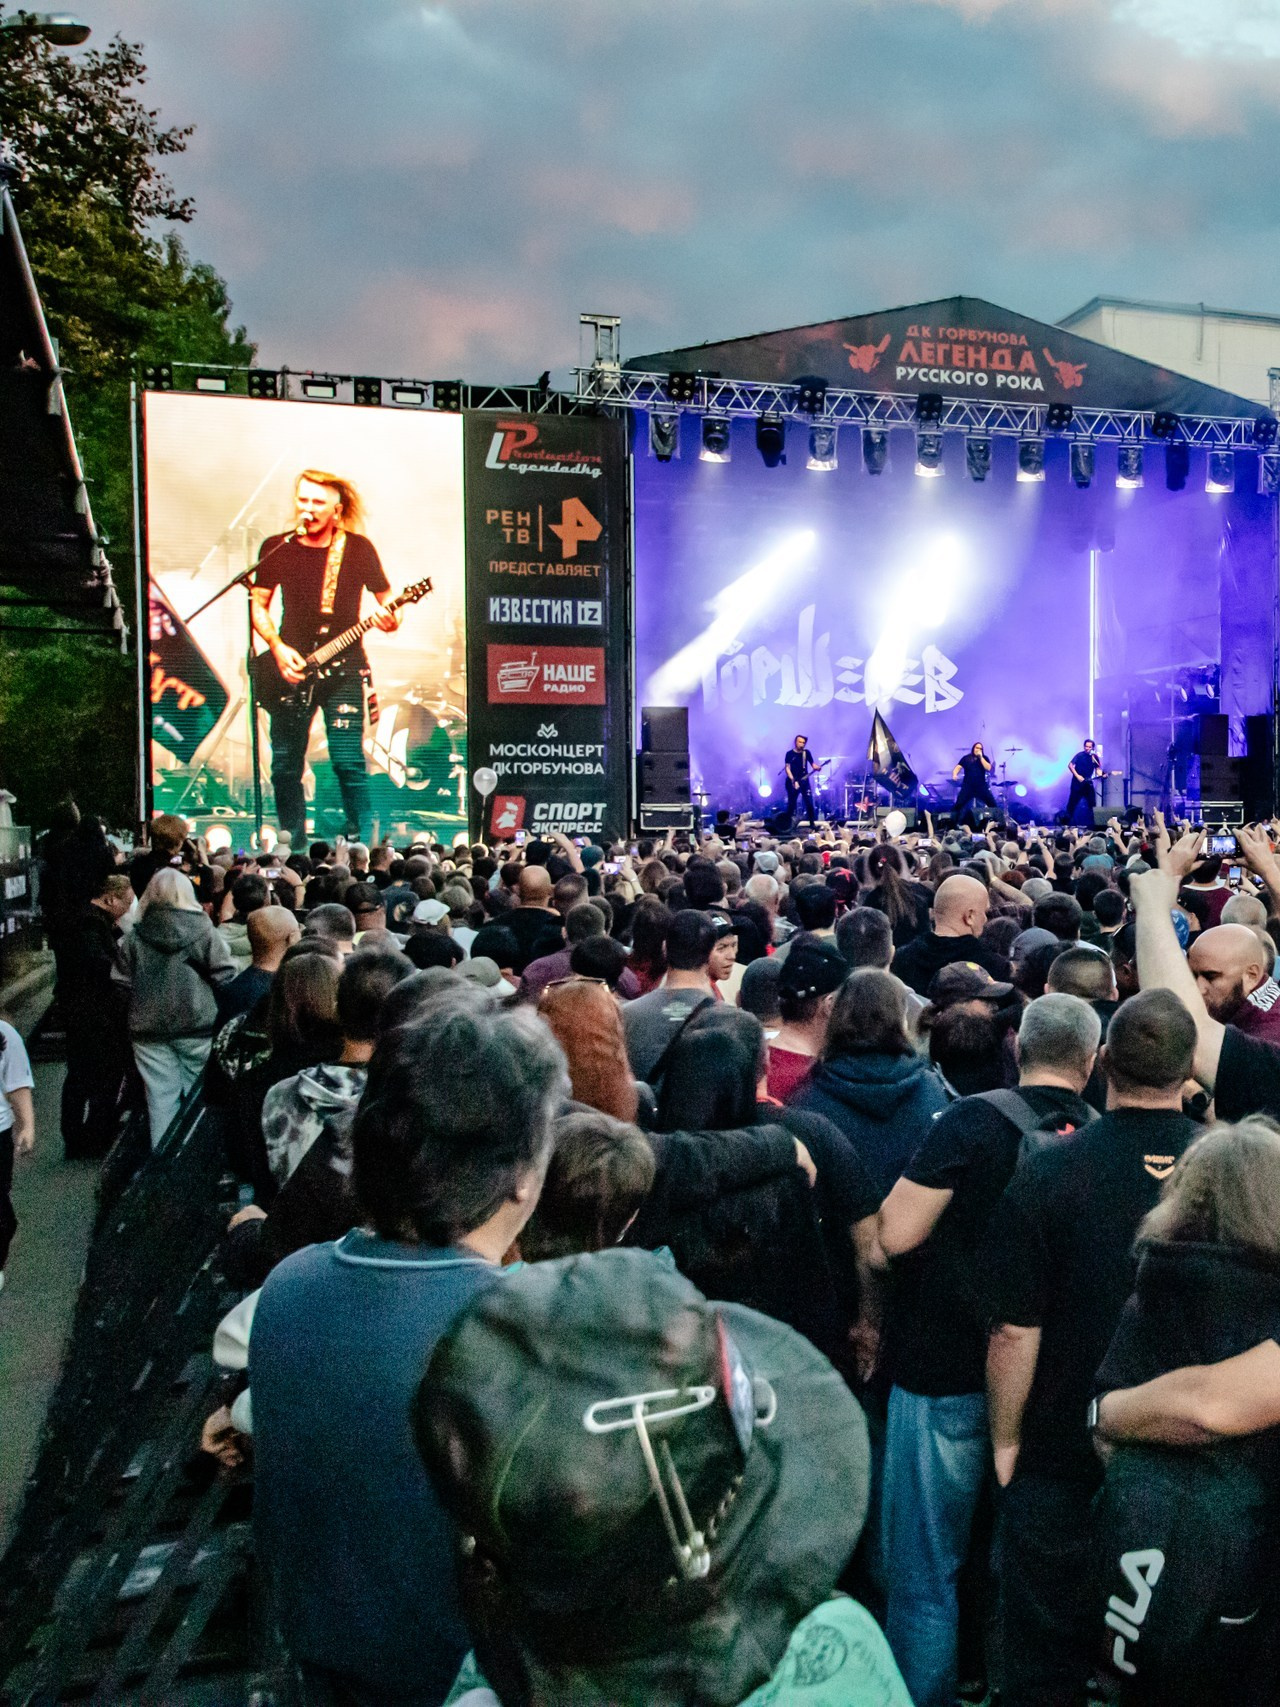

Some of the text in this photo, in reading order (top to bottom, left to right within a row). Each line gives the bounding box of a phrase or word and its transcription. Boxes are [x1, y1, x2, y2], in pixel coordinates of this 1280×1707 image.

[906, 325, 1028, 346] ДК ГОРБУНОВА
[899, 340, 1038, 374] ЛЕГЕНДА
[896, 365, 1044, 391] РУССКОГО РОКА
[486, 509, 531, 526] РЕН
[501, 528, 530, 544] ТВ
[489, 560, 601, 577] ПРЕДСТАВЛЯЕТ
[489, 597, 573, 624] ИЗВЕСТИЯ
[543, 663, 597, 682] НАШЕ
[543, 684, 586, 693] РАДИО
[489, 744, 605, 758] МОСКОНЦЕРТ
[492, 762, 605, 776] ДК ГОРБУНОВА
[533, 803, 607, 820] СПОРТ
[531, 822, 602, 833] ЭКСПРЕСС
[1104, 1549, 1166, 1676] FILA
